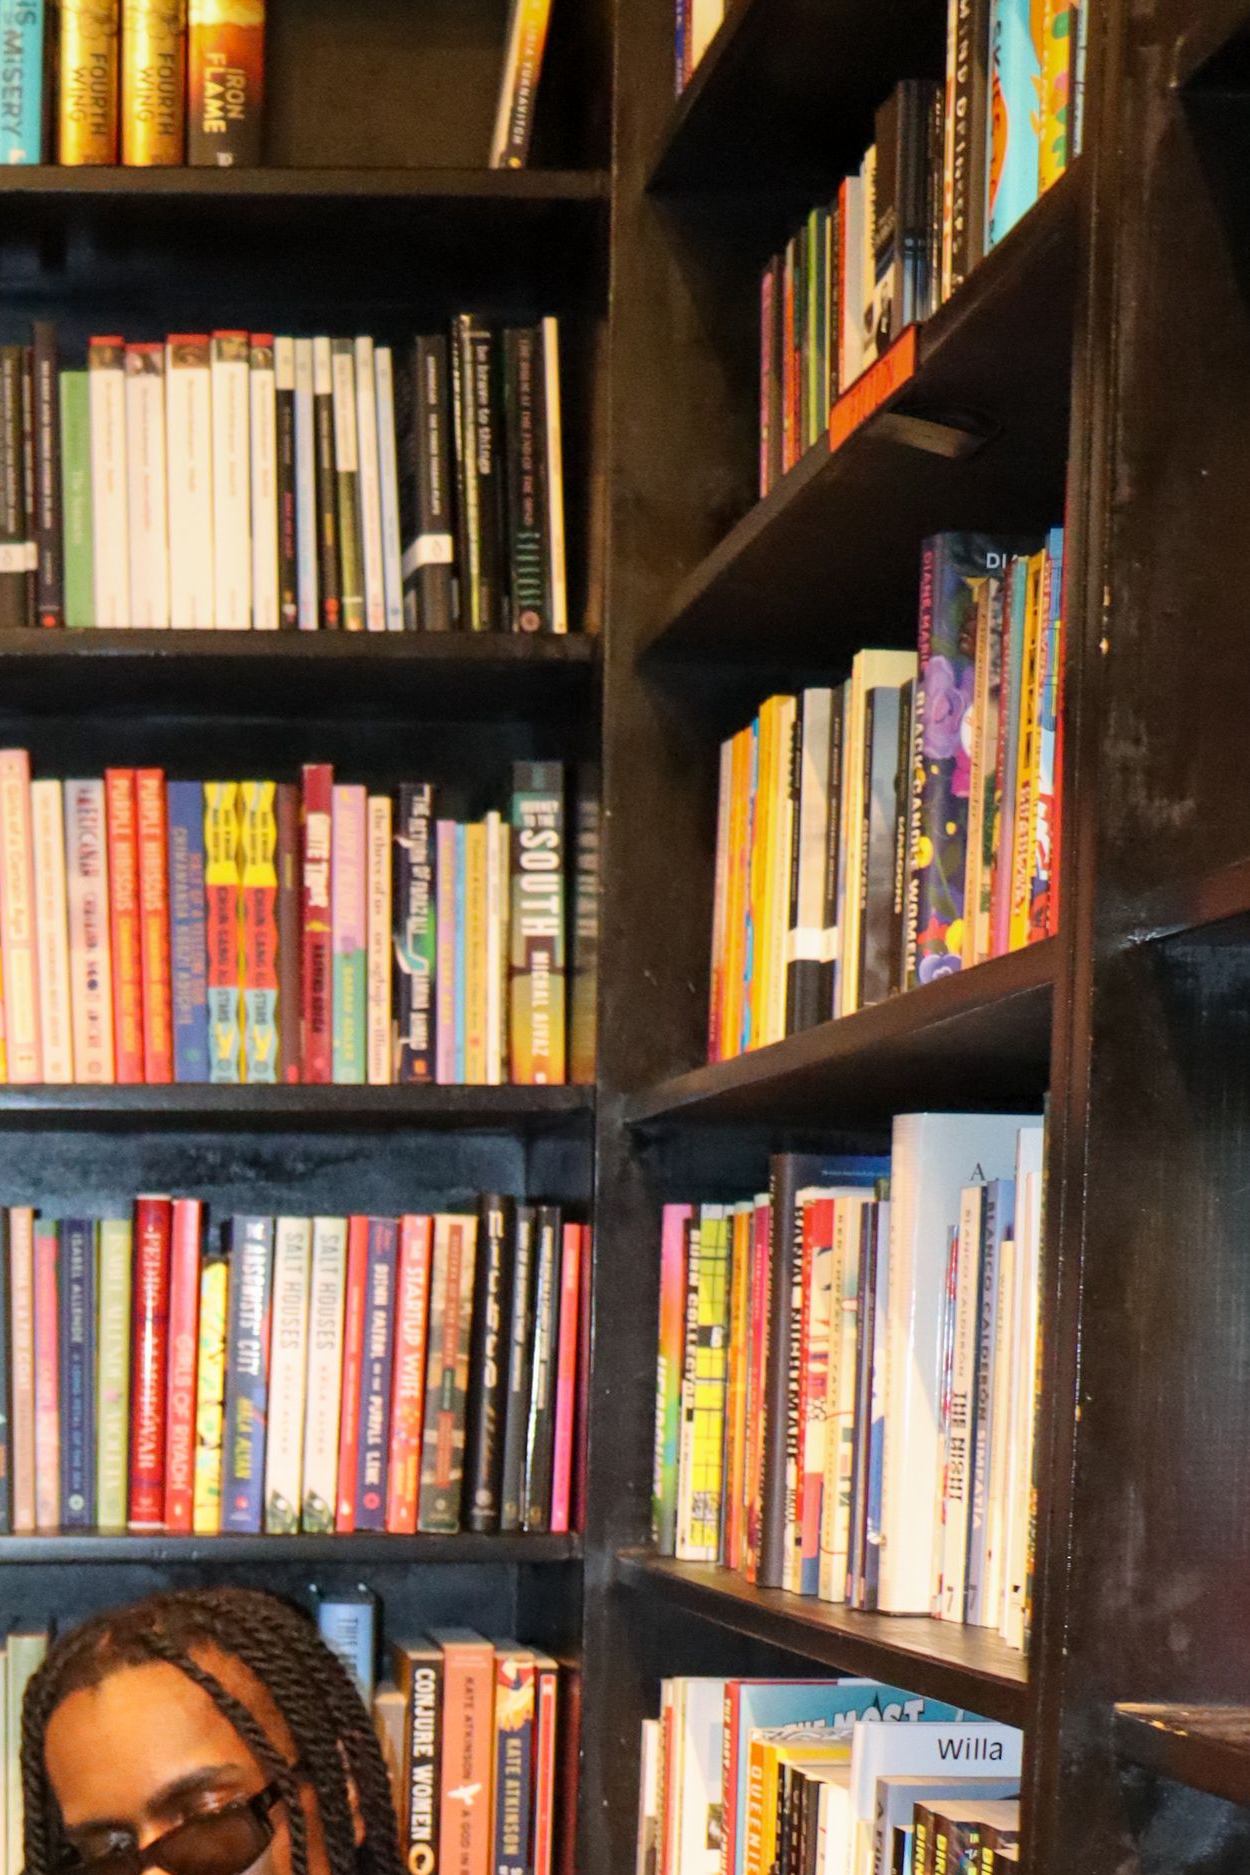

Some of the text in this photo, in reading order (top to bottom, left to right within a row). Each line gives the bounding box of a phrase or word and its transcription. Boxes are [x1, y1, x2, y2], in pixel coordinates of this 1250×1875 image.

[69, 66, 88, 122] WING
[90, 53, 108, 135] FOURTH
[136, 67, 155, 122] WING
[157, 52, 175, 136] FOURTH
[203, 52, 225, 133] FLAME
[226, 69, 244, 120] IRON
[477, 363, 492, 404] brave
[477, 427, 493, 475] things
[112, 778, 133, 912] PURPLE HIBISCUS
[142, 778, 163, 912] PURPLE HIBISCUS
[520, 829, 559, 937] SOUTH
[531, 951, 549, 1008] MICHAL
[281, 1232, 304, 1350] SALT HOUSES
[317, 1233, 340, 1351] SALT HOUSES
[399, 1266, 425, 1399] STARTUP WIFE
[172, 1334, 193, 1491] GIRLS OF RIYADH
[411, 1668, 436, 1841] CONJURE WOMEN
[502, 1737, 523, 1856] KATE ATKINSON
[937, 1738, 1004, 1760] Willa
[745, 1765, 764, 1875] QUEENIE
